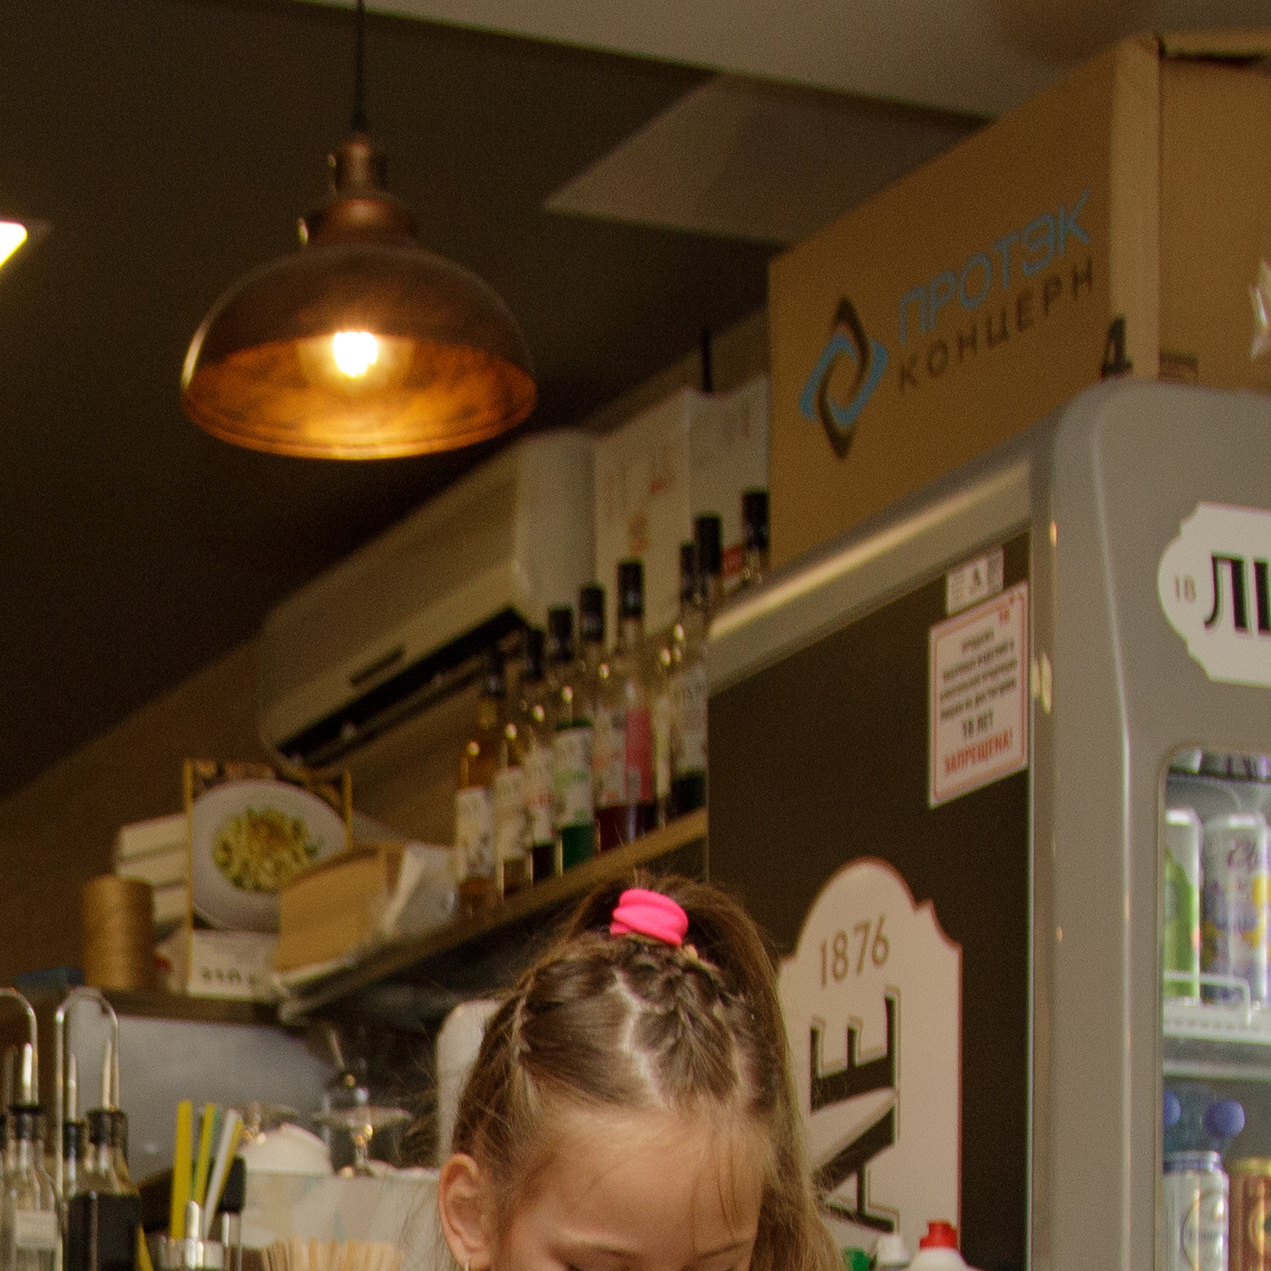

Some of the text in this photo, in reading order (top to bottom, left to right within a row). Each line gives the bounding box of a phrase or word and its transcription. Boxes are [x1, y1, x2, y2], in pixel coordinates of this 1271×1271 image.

[899, 188, 1092, 346] ПРОТЭК
[899, 255, 1094, 394] КОНЦЕРН
[817, 914, 891, 988] 1876
